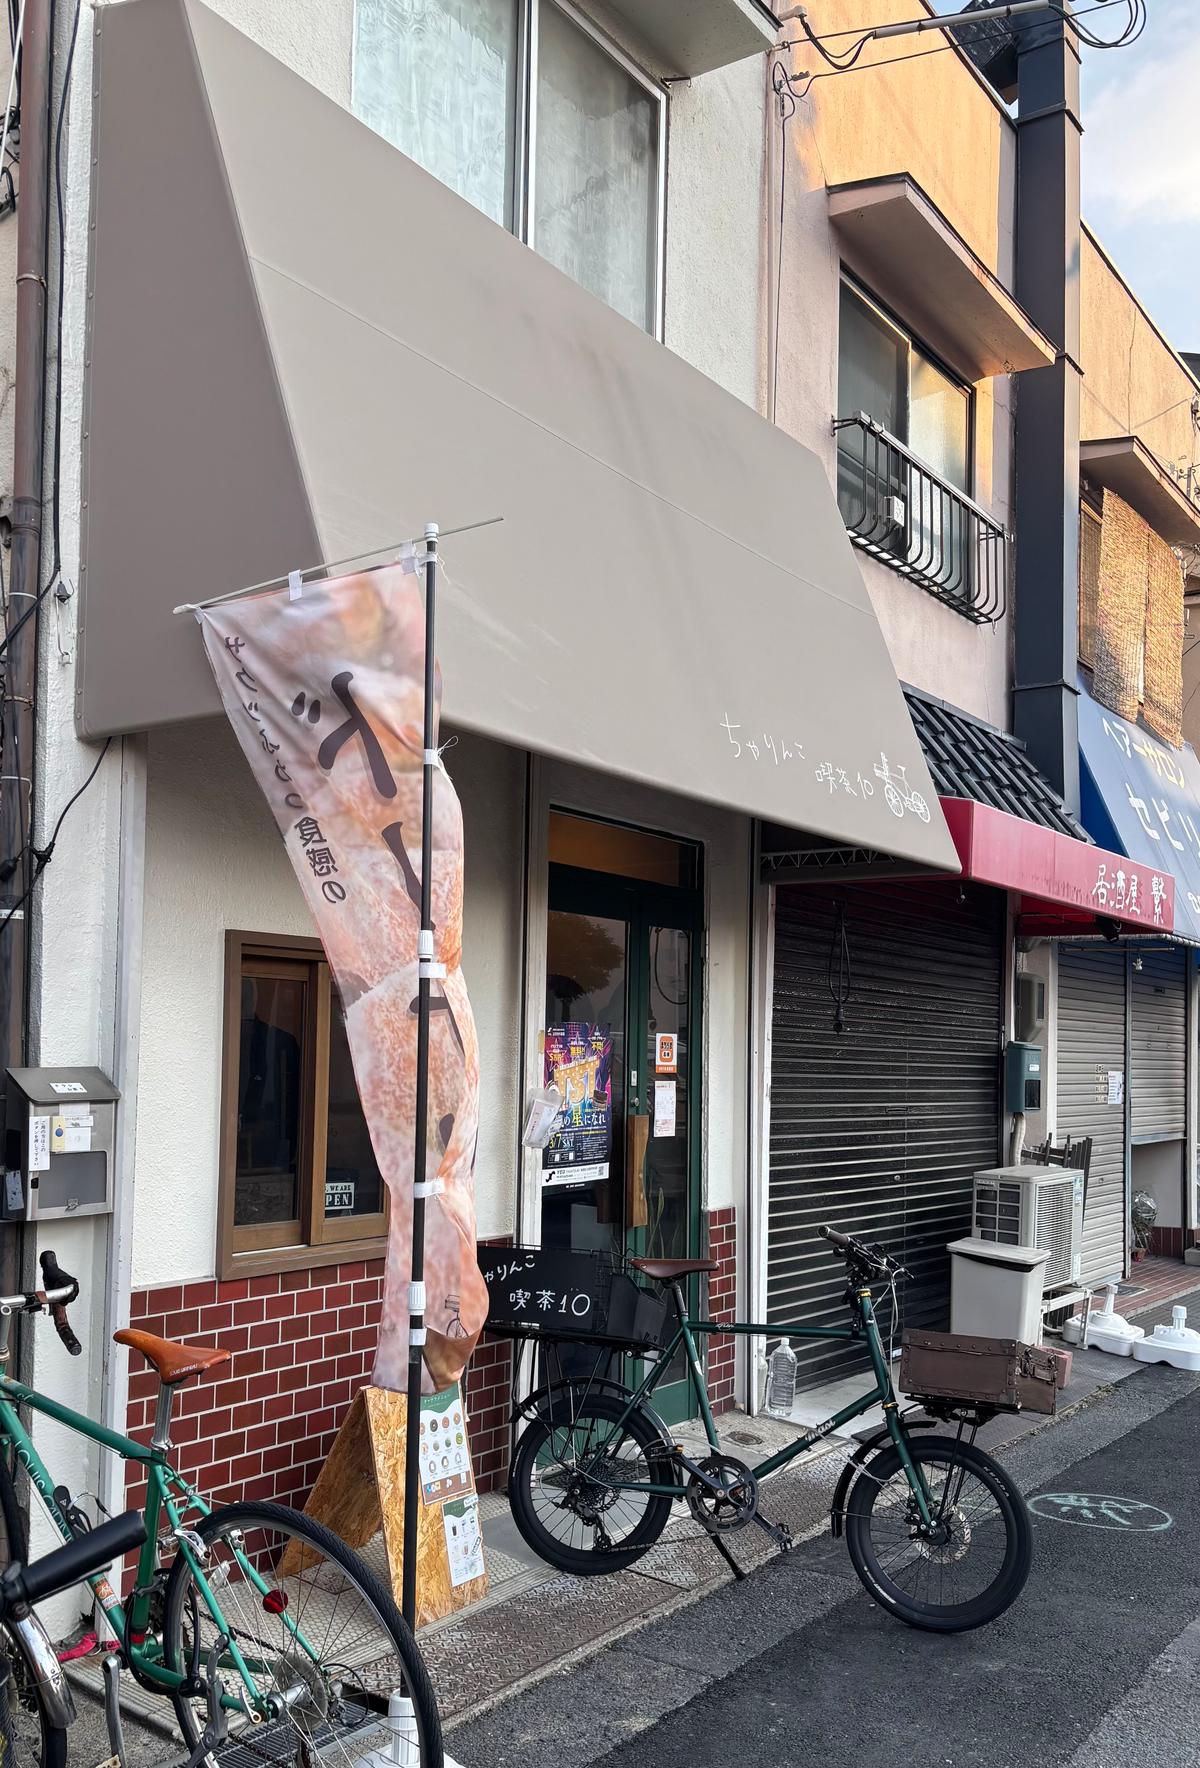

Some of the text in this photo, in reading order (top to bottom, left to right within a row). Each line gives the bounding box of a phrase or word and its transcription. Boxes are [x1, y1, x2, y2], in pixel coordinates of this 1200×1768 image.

[719, 711, 805, 766] ちゃりんこ
[1102, 717, 1185, 789] ヘアーサロン
[814, 761, 874, 800] 喫茶10
[1092, 864, 1140, 915] 居酒屋
[325, 1193, 350, 1206] PEN
[484, 1254, 536, 1283] ゃりんこ
[509, 1288, 591, 1317] 喫茶10
